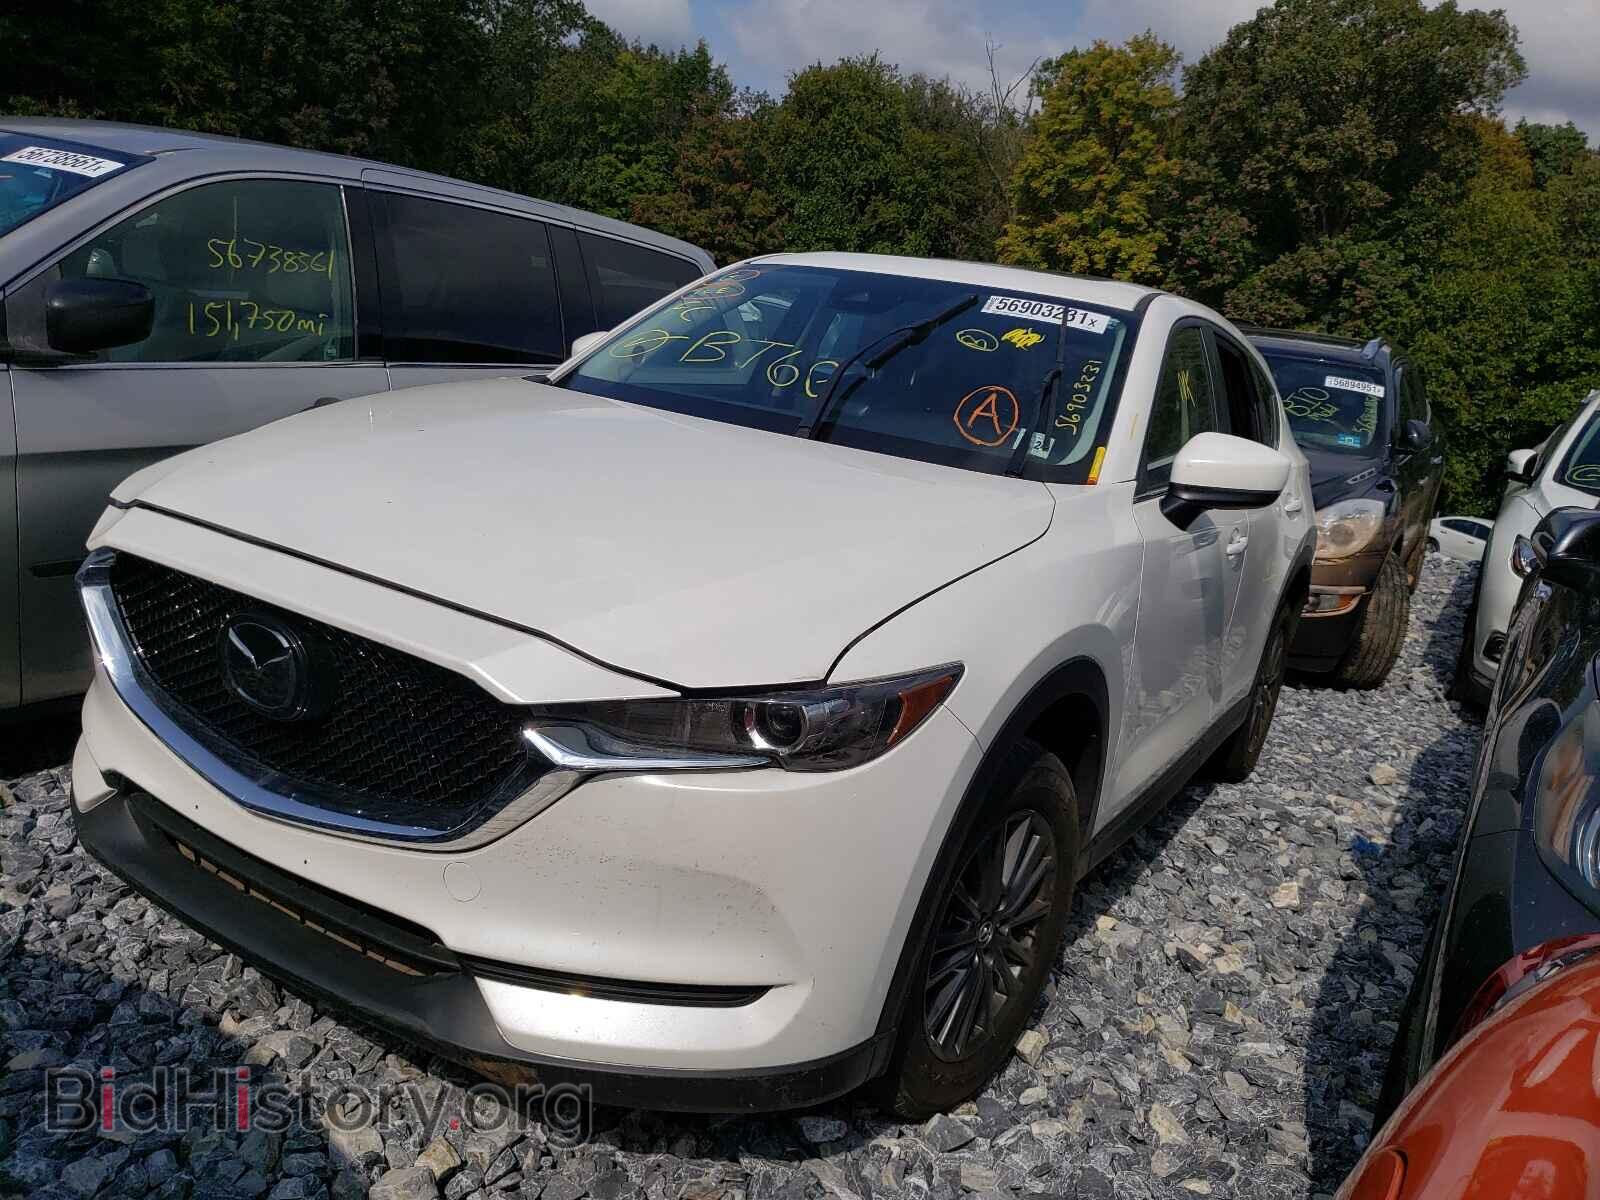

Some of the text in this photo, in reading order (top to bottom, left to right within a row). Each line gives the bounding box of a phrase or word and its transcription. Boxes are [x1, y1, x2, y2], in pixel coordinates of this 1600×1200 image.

[207, 238, 336, 281] 56738561
[967, 391, 1002, 434] A
[1055, 360, 1104, 436] 56903231
